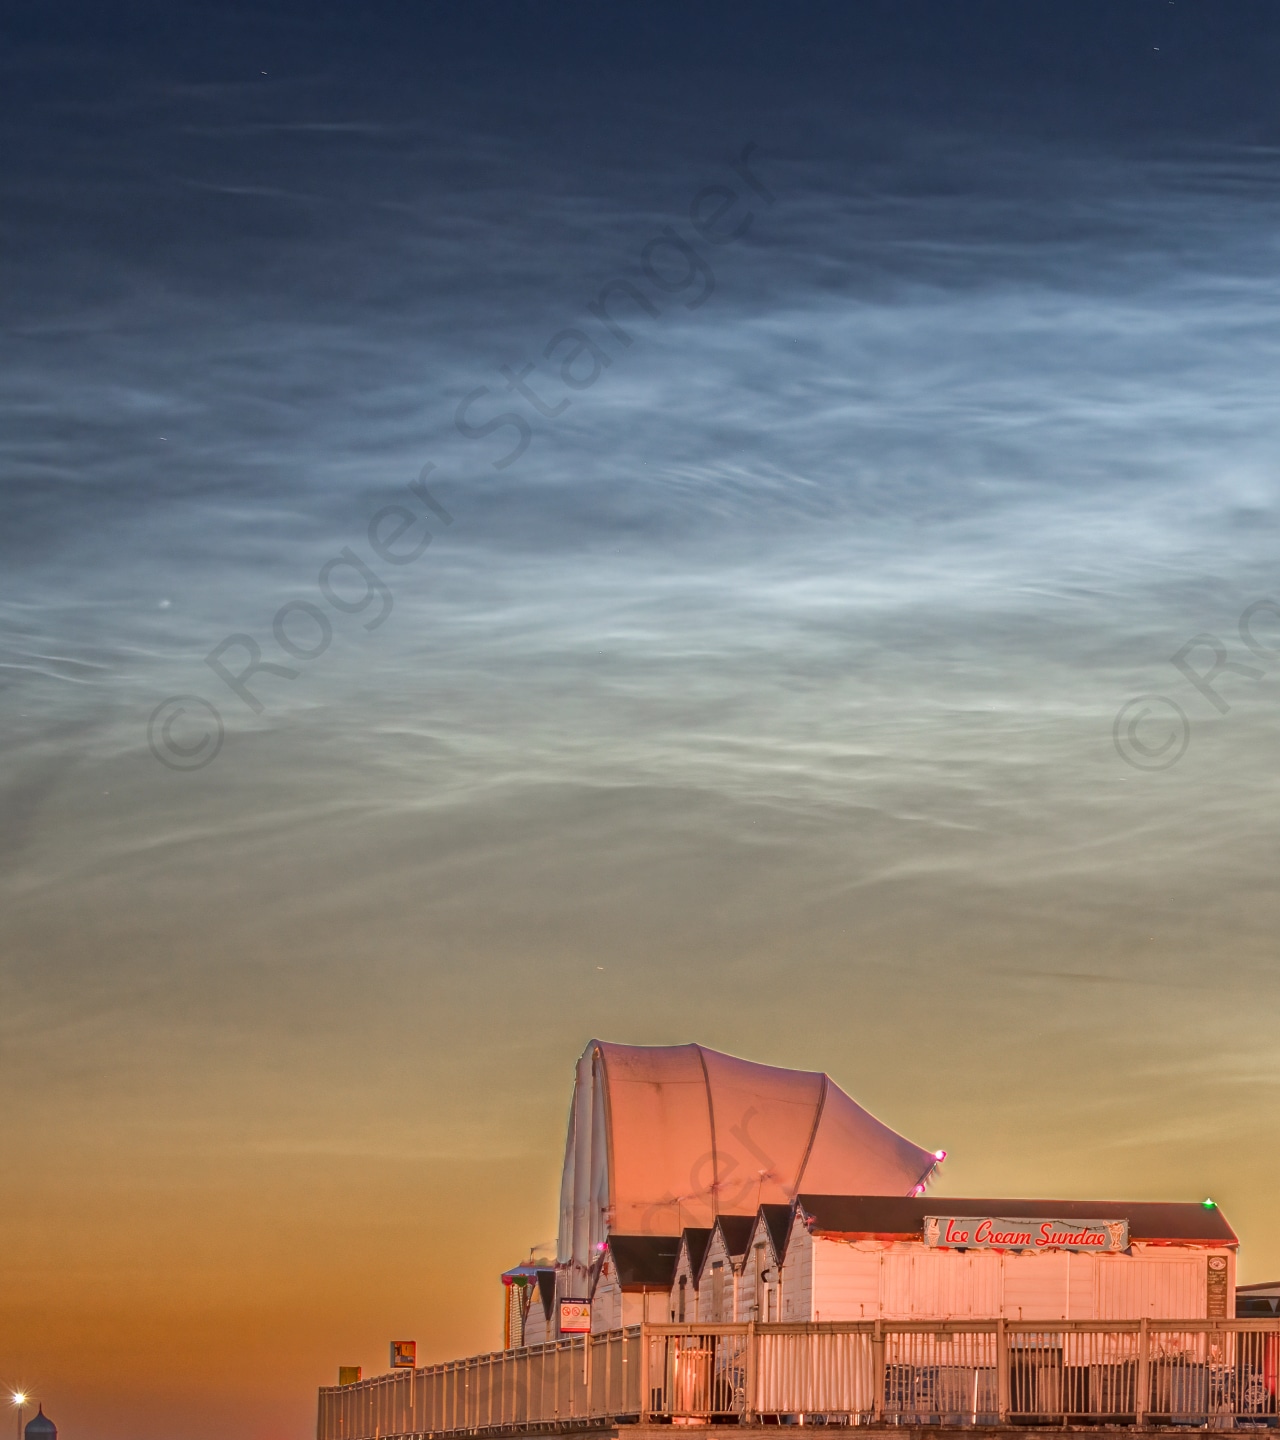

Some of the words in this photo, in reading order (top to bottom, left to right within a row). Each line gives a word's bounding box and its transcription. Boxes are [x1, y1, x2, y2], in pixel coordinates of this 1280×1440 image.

[945, 1219, 969, 1243] Ice
[974, 1220, 1031, 1245] Cream
[1035, 1222, 1106, 1246] Sundae
